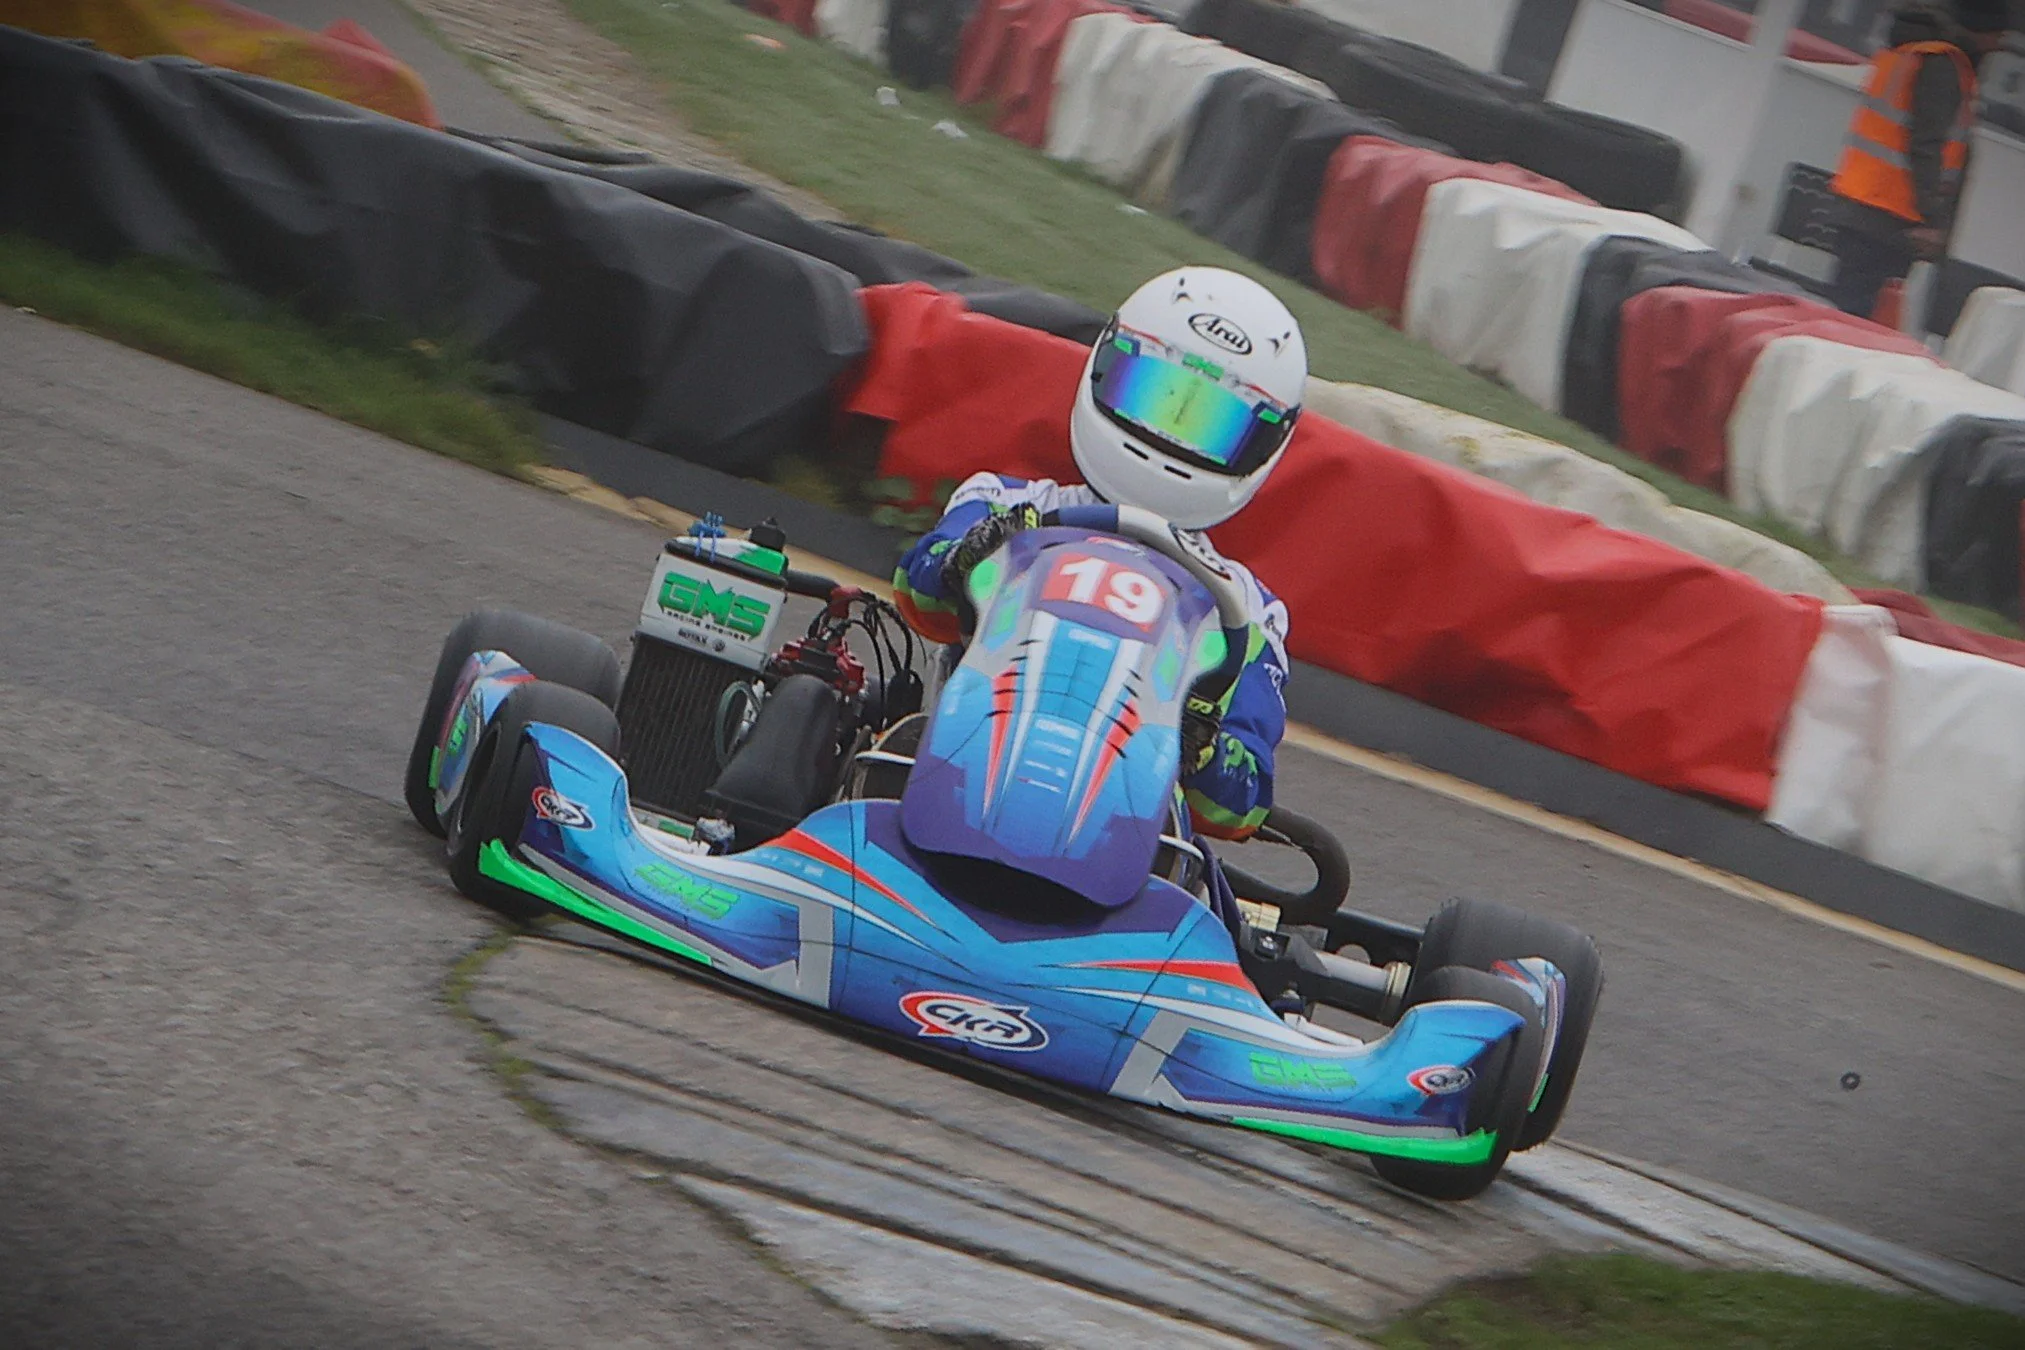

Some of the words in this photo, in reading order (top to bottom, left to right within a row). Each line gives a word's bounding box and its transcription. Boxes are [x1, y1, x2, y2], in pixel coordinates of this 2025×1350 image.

[1197, 317, 1246, 350] Arai
[658, 570, 771, 638] GMS
[1059, 556, 1163, 624] 19
[634, 862, 741, 919] GMS
[925, 1003, 1024, 1039] CKR
[1248, 1051, 1358, 1090] GMS
